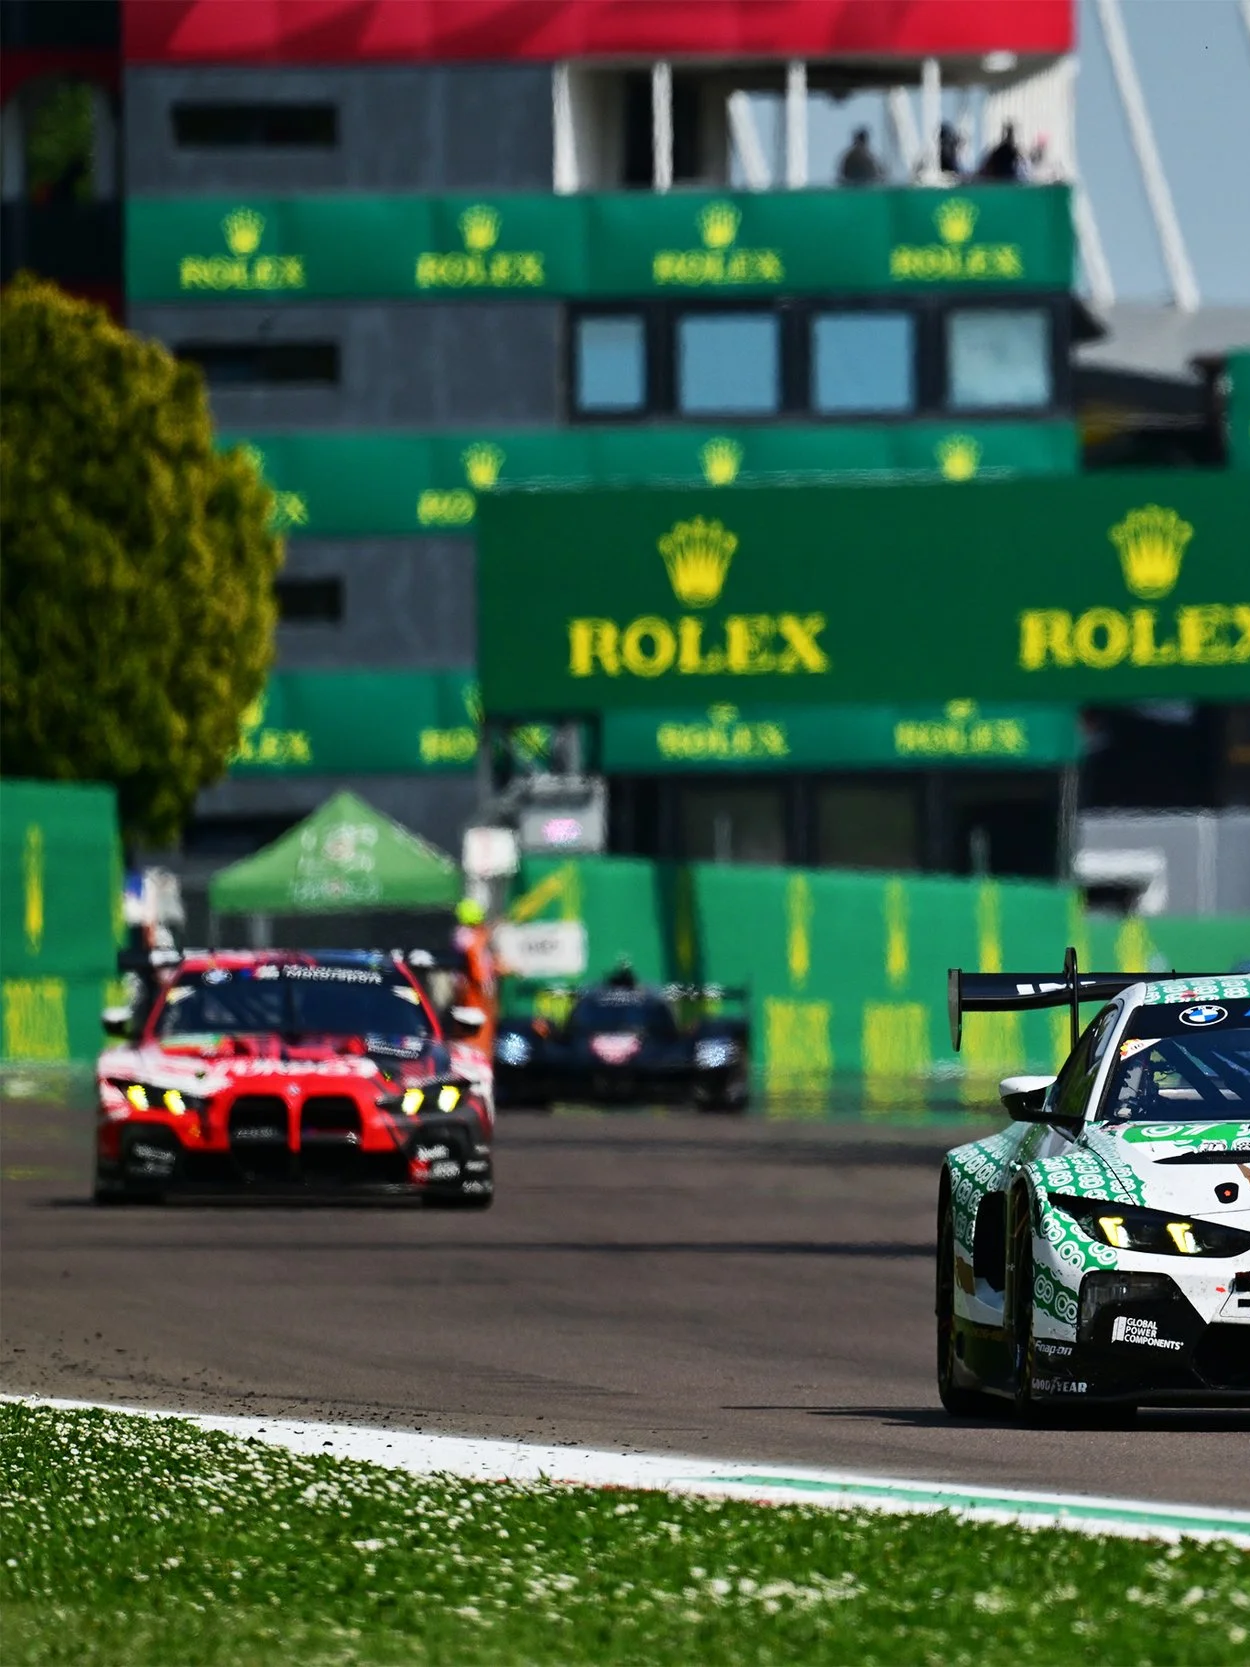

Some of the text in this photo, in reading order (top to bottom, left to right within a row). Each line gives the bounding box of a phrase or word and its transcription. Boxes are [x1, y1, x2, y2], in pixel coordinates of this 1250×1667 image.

[180, 254, 304, 289] ROLEX
[416, 252, 544, 288] ROLEX
[653, 249, 784, 285] ROLEX
[890, 244, 1022, 281] ROLEX
[568, 613, 829, 676] ROLEX
[657, 722, 790, 760] ROLEX
[894, 720, 1027, 757] ROLEX
[1124, 1333, 1181, 1350] COMPONENTS
[1125, 1325, 1157, 1338] POWER
[1126, 1317, 1158, 1330] GLOBAL
